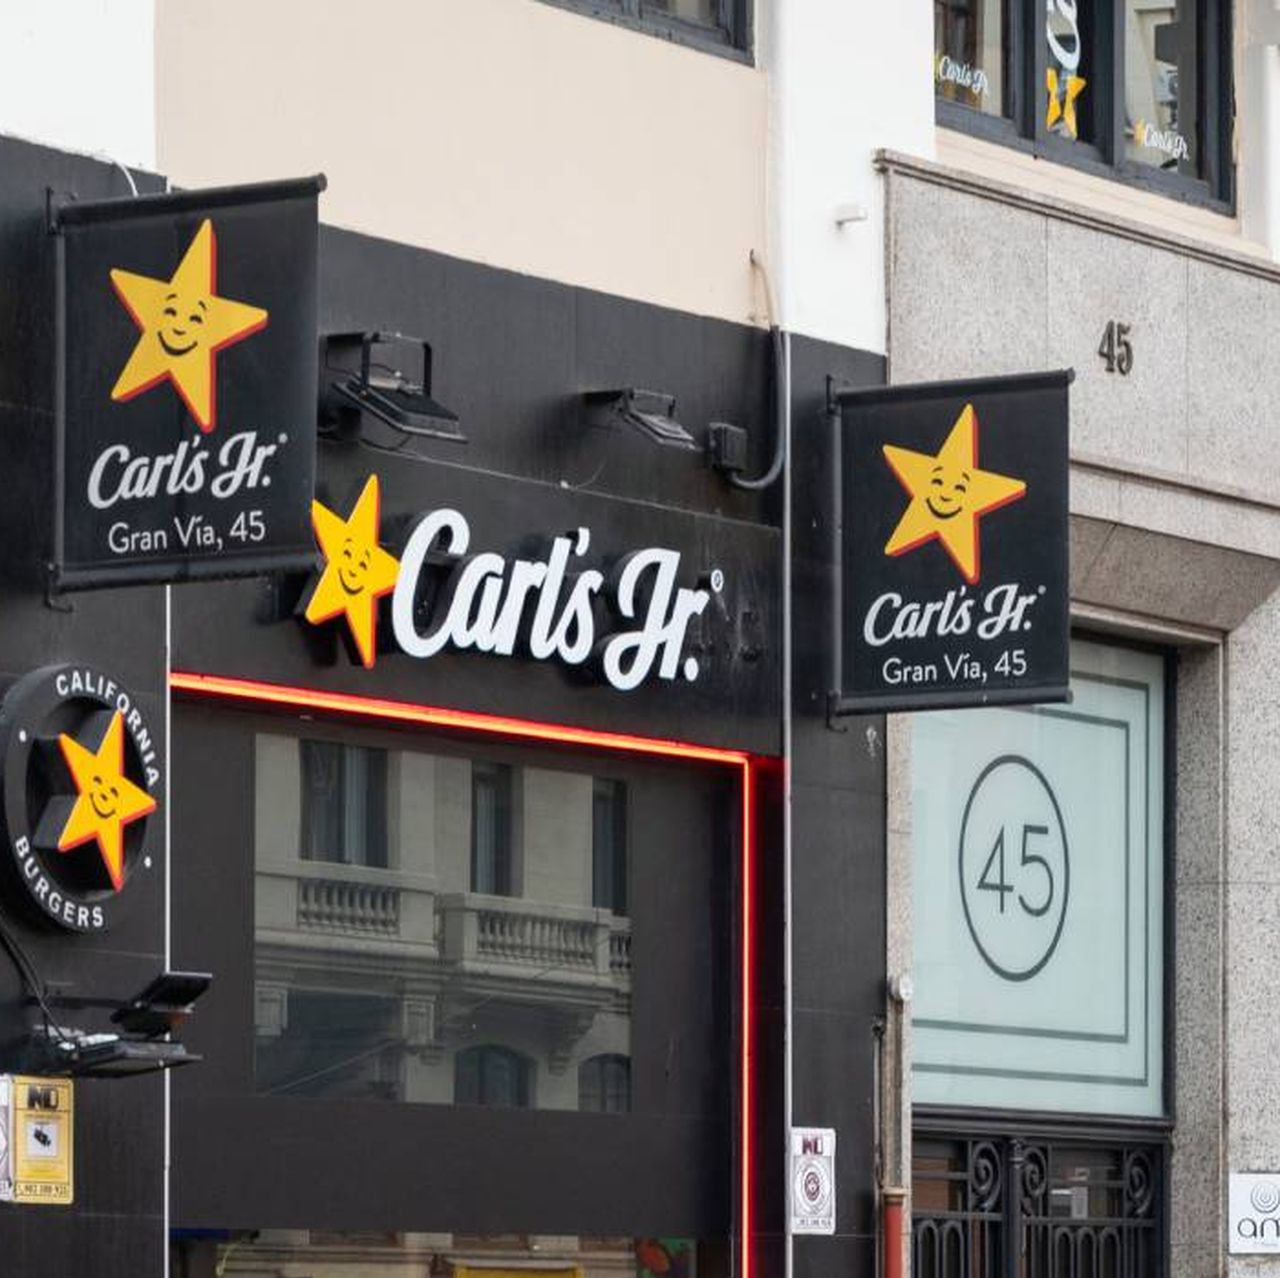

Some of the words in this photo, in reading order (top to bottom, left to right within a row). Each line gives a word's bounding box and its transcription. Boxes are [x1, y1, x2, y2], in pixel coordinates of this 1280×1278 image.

[1098, 320, 1133, 375] 45
[88, 434, 208, 509] Carl's
[109, 523, 167, 554] Gran
[231, 511, 266, 542] 45
[392, 508, 605, 664] Carl's
[863, 584, 974, 646] Carl's
[882, 658, 937, 684] Gran
[994, 650, 1028, 675] 45
[56, 670, 159, 786] CALIFORNIA
[15, 836, 104, 928] BURGERS
[976, 823, 1055, 918] 45
